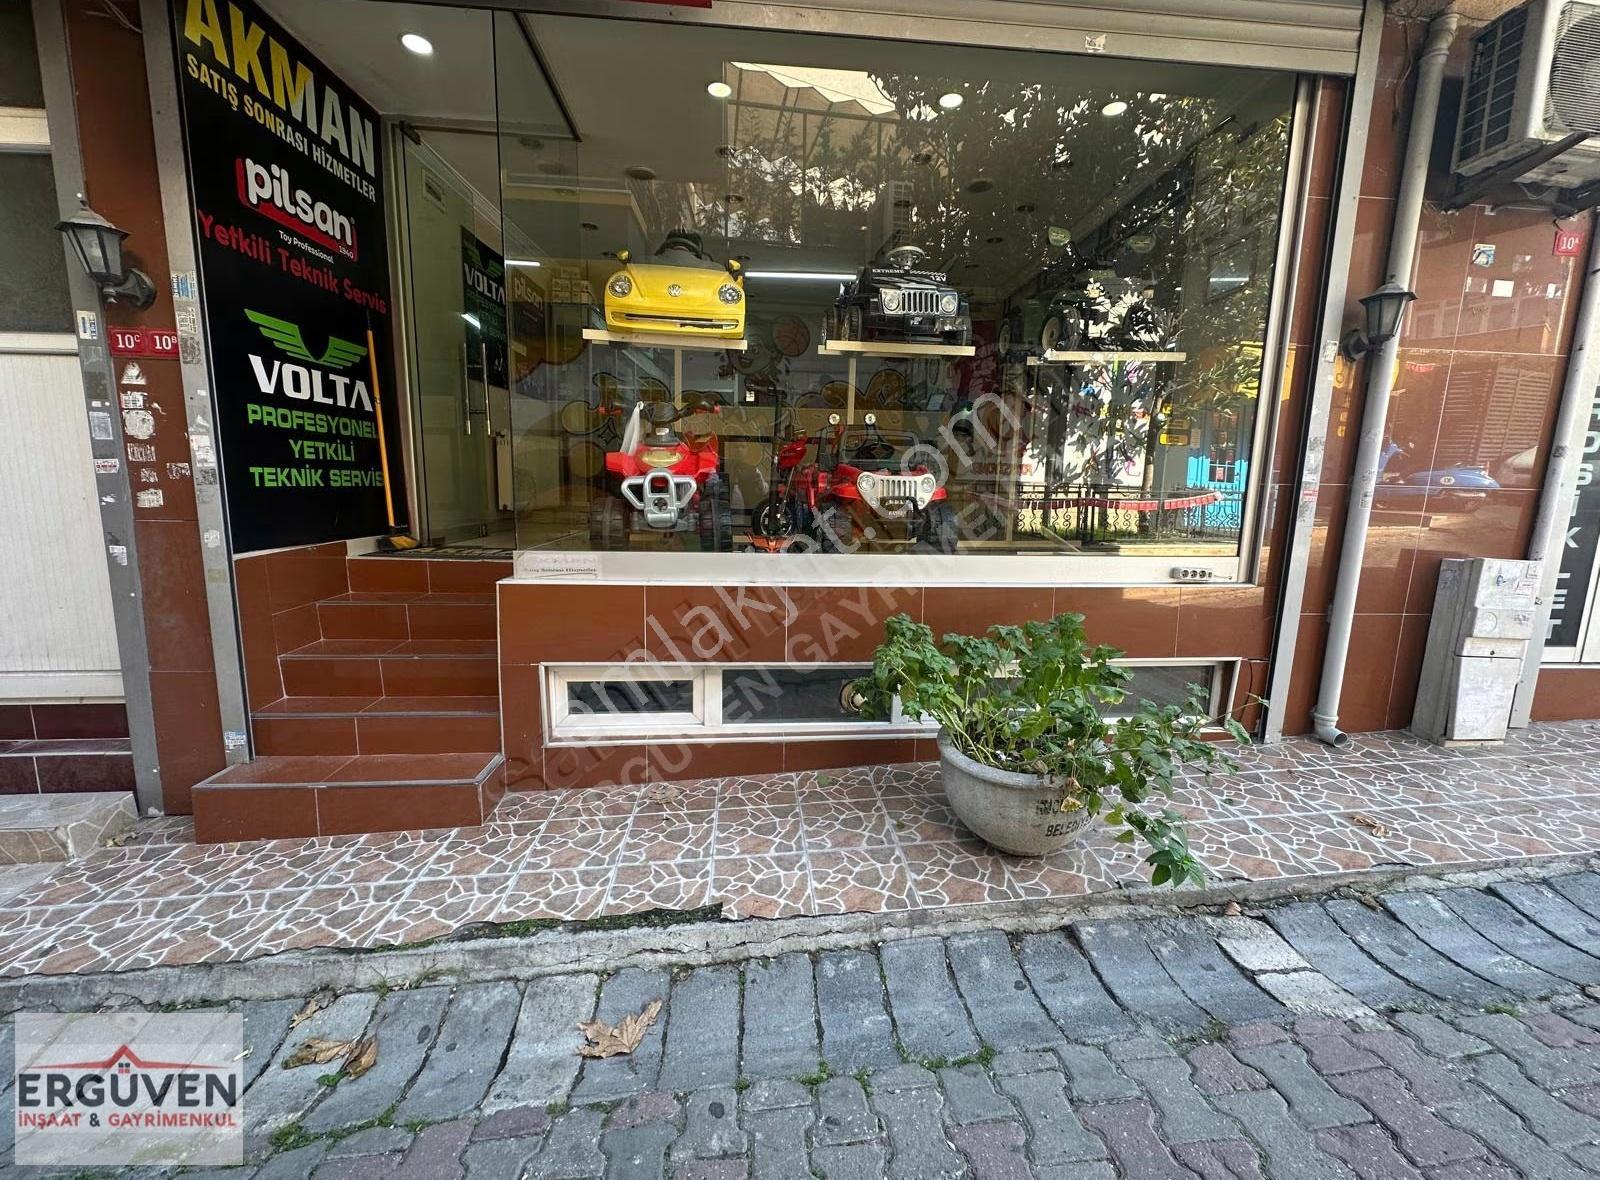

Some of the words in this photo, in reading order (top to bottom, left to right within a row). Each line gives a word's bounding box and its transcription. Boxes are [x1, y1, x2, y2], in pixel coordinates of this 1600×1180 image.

[184, 0, 375, 178] AKMAN
[187, 53, 239, 111] SATIŞ
[243, 95, 309, 156] SONRASI
[312, 143, 376, 202] HİZMETLER
[245, 158, 353, 246] pilsan
[197, 208, 272, 265] Yetkili
[277, 247, 339, 294] Teknik
[343, 277, 387, 315] Servis
[279, 229, 293, 246] Toy
[293, 236, 335, 264] Professional
[463, 262, 506, 306] VOLTA
[248, 353, 374, 412] VOLTA
[247, 403, 378, 439] PROFESYONEL
[249, 463, 325, 488] TEKNİK
[329, 466, 385, 488] SERVİS
[288, 438, 355, 462] YETKİLİ
